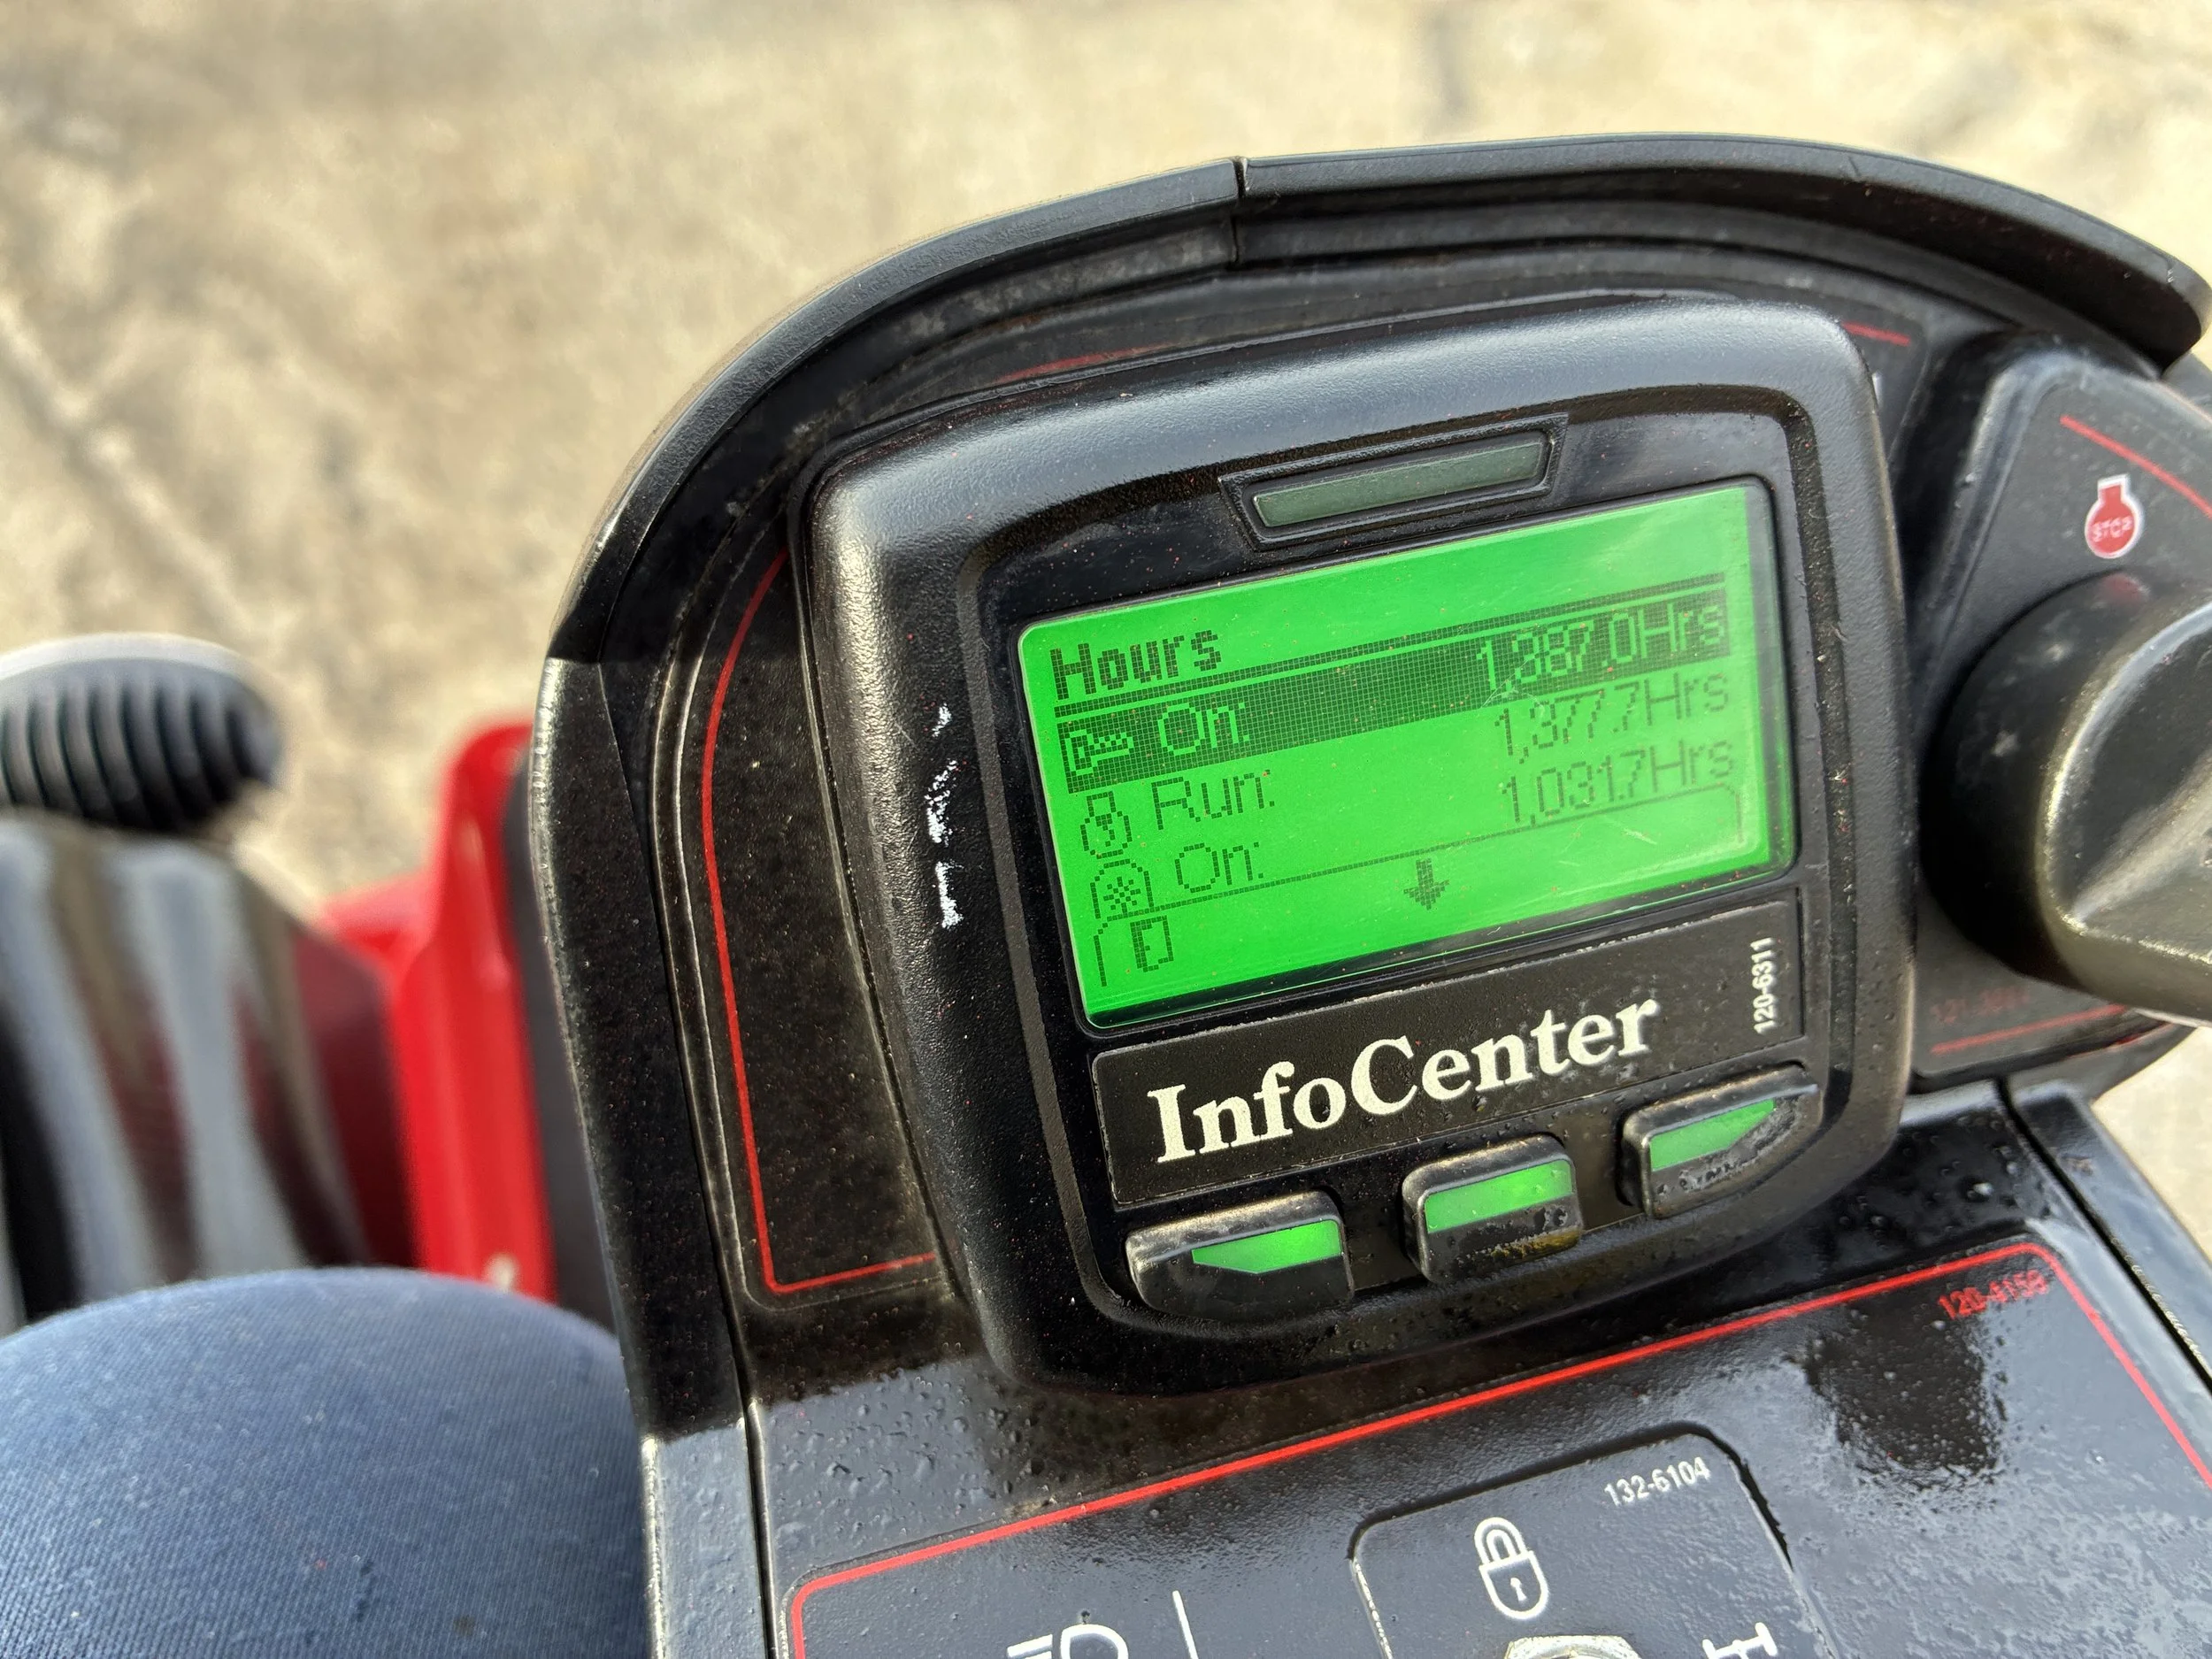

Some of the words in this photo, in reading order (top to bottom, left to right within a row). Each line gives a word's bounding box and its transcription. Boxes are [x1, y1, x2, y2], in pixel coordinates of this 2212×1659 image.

[2090, 516, 2133, 543] STOP
[1049, 629, 1222, 701] Hours
[1152, 769, 1275, 831] Run:
[1494, 671, 1729, 764] 1,377.7Hrs
[1156, 702, 1250, 757] On:
[1174, 841, 1264, 894] On:
[1750, 937, 1777, 1034] 120-6311
[1147, 998, 1659, 1164] InfoCenter
[1603, 1456, 1711, 1508] 132-6104
